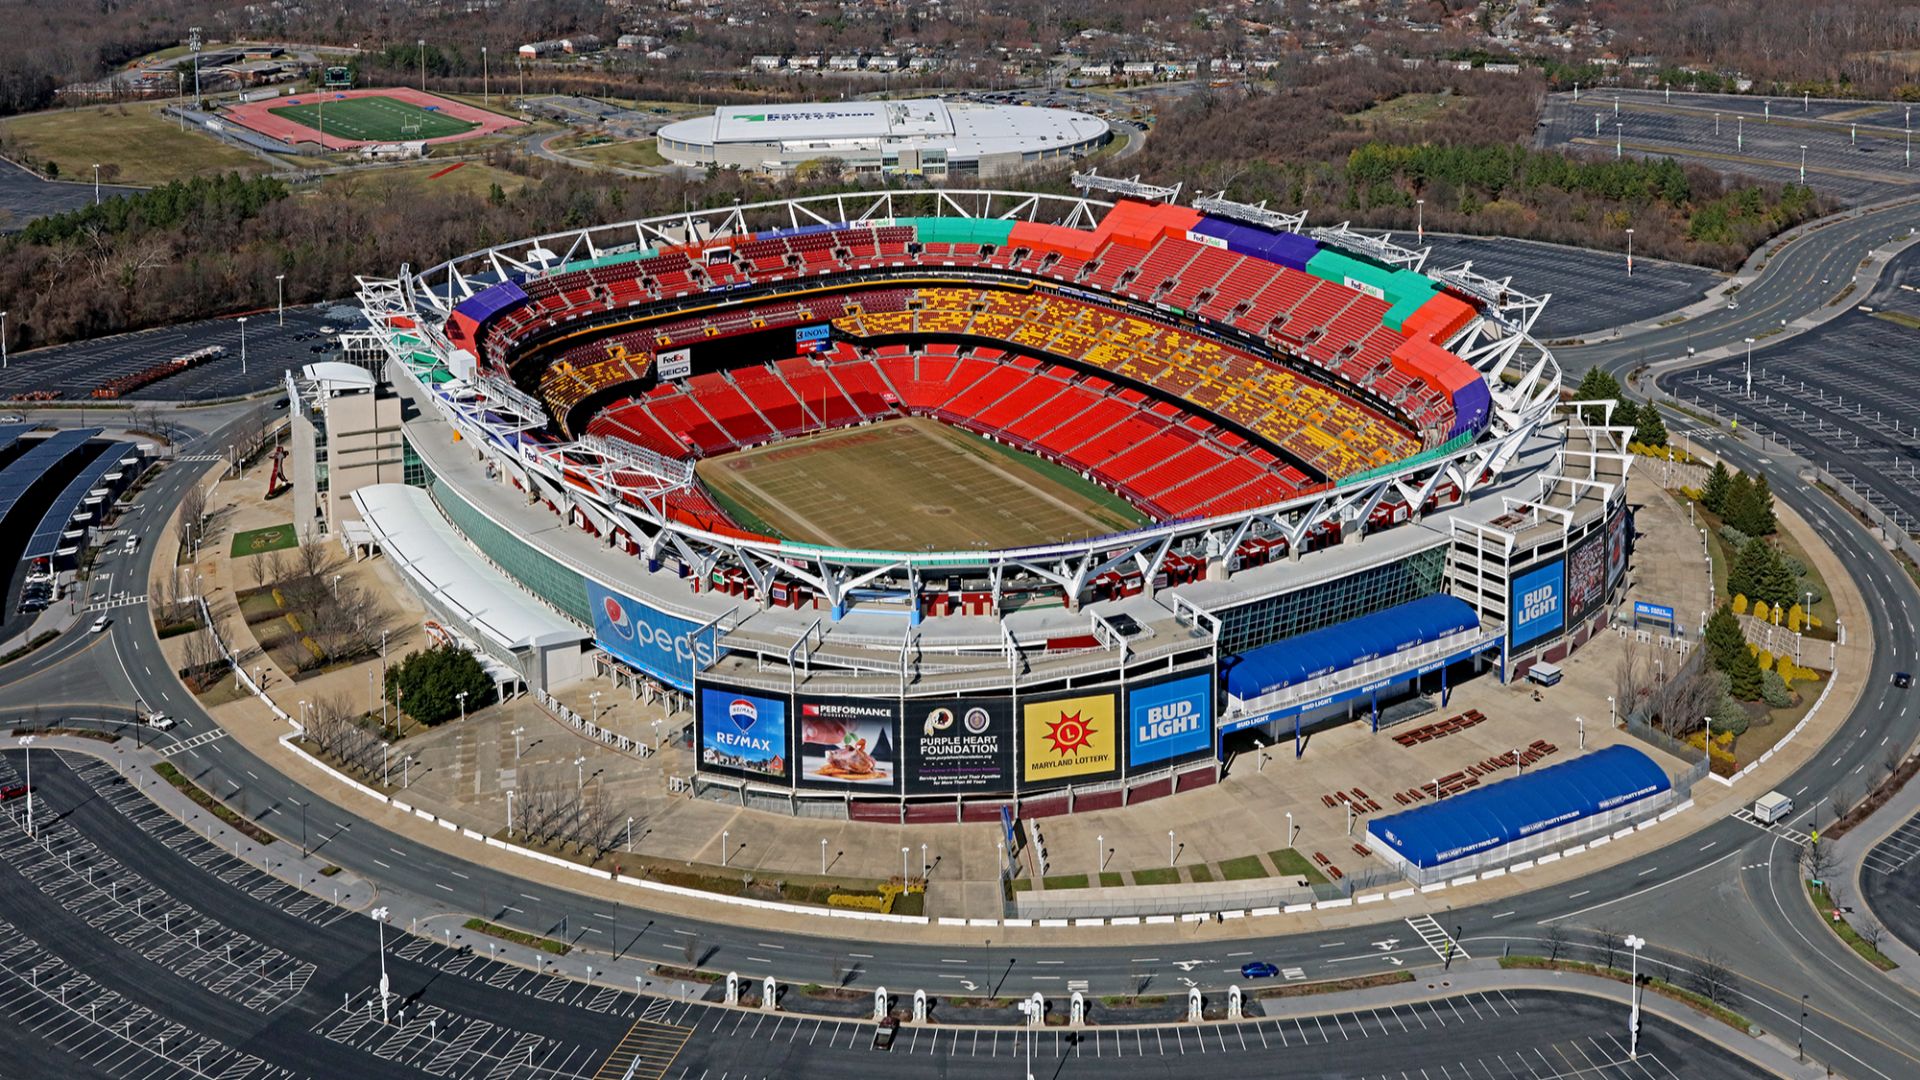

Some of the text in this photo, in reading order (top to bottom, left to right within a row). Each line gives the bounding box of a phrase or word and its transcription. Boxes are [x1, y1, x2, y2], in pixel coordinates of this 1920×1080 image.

[1193, 233, 1221, 247] FedExField
[1351, 280, 1377, 295] FedExField
[804, 328, 828, 337] INOVA
[663, 354, 684, 364] FedEx
[659, 366, 688, 377] GEICO
[1523, 585, 1553, 608] BUD
[1518, 596, 1558, 624] LIGHT
[636, 620, 713, 665] peps
[1471, 641, 1496, 655] BUD LIGHT
[1418, 660, 1445, 674] BUD LIGHT
[1362, 679, 1390, 693] BUD LIGHT
[820, 705, 891, 717] PERFORMANCE
[1302, 698, 1332, 711] BUD LIGHT
[1148, 700, 1192, 724] BUD
[1139, 713, 1201, 742] LIGHT
[1236, 715, 1269, 729] BUD LIGHT
[920, 736, 998, 746] PURPLE HEART
[1066, 728, 1075, 740] L
[717, 732, 771, 751] RE/MAX
[920, 744, 998, 755] FOUNDATION
[1032, 758, 1072, 770] MARYLAND
